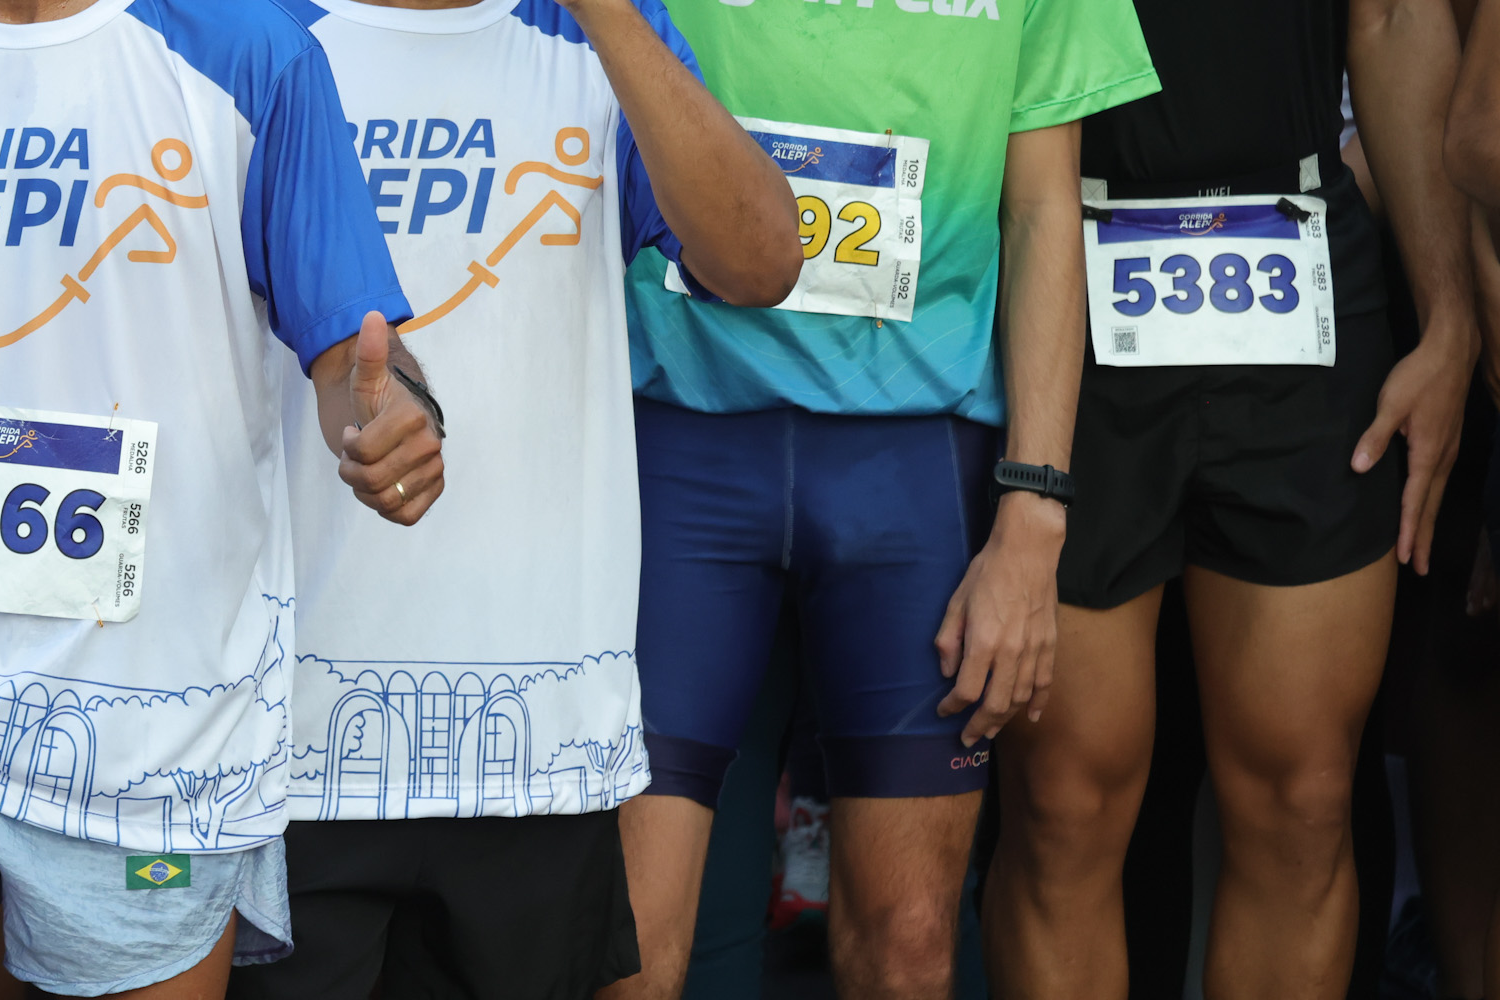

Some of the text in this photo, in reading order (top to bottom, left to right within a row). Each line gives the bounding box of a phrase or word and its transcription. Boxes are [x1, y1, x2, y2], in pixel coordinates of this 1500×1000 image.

[346, 118, 496, 159] RIDA
[772, 142, 808, 152] CORRIDA
[772, 149, 807, 161] ALEPI
[907, 159, 919, 188] 1092
[904, 215, 915, 244] 1092
[898, 272, 911, 300] 1092
[1112, 253, 1300, 317] 5383
[1316, 263, 1327, 292] 5383
[1320, 317, 1331, 345] 5383
[135, 441, 148, 474] 5266
[128, 503, 141, 534] 5266
[123, 564, 136, 597] 5266
